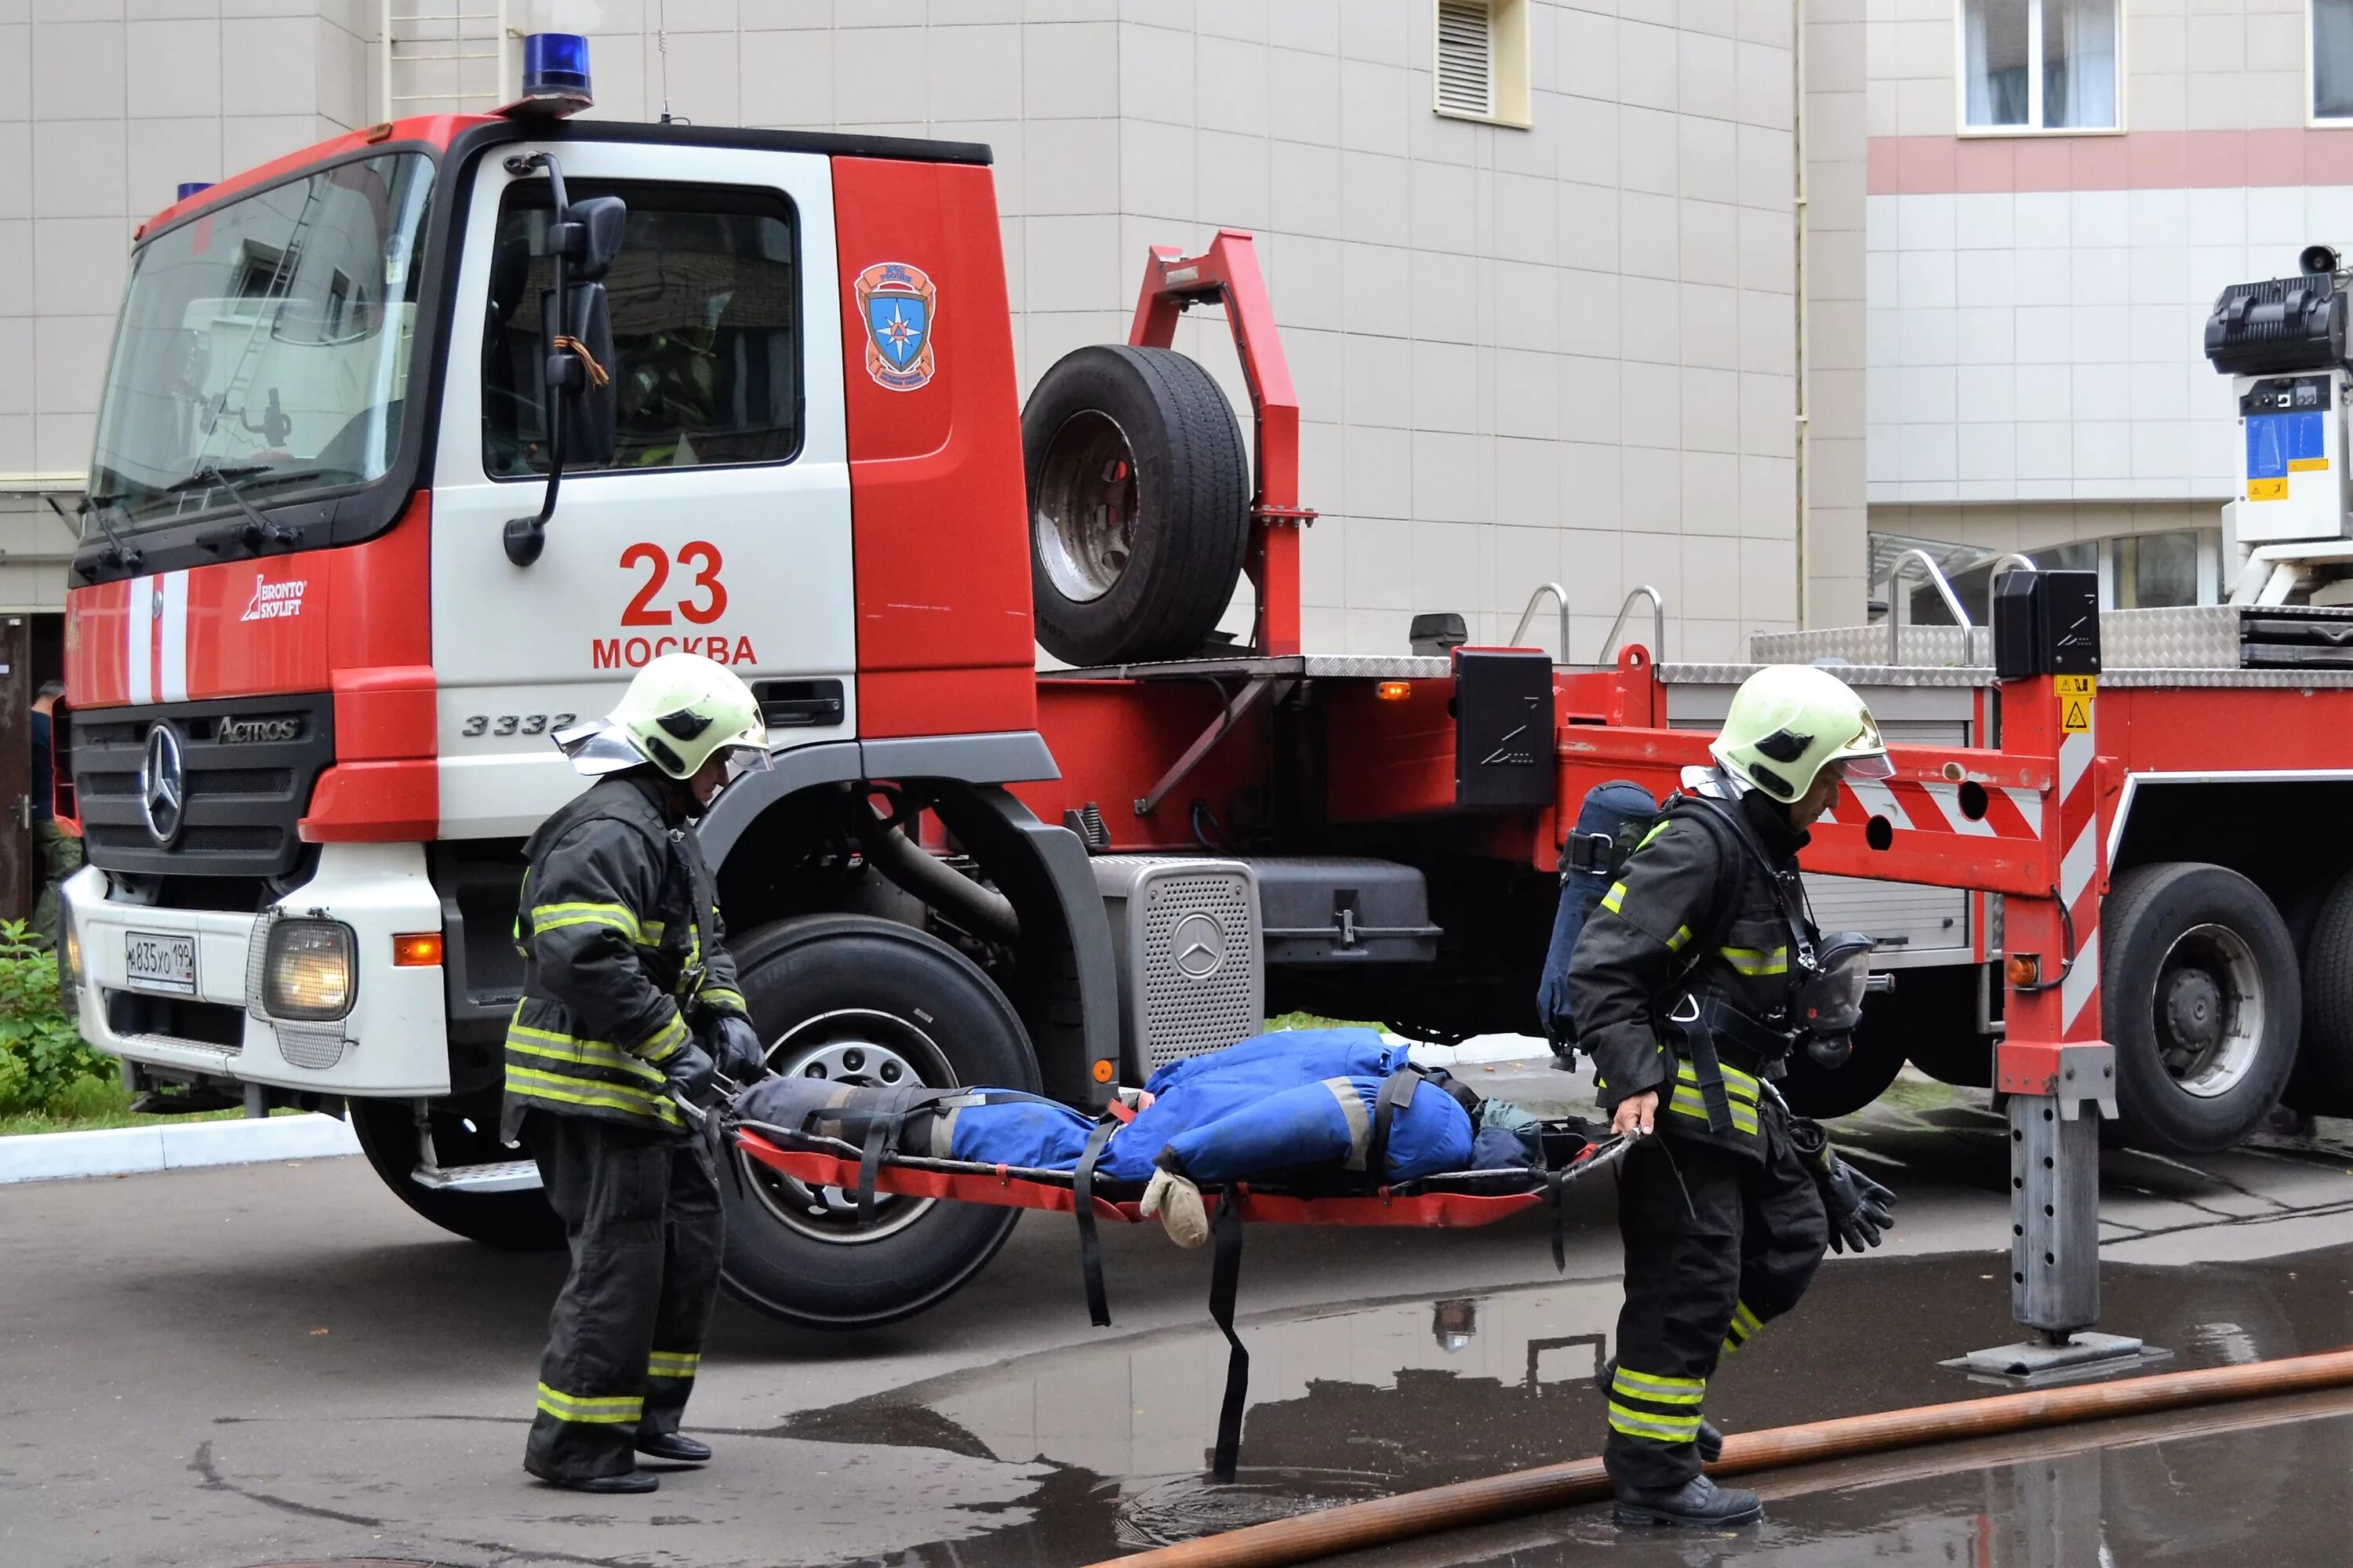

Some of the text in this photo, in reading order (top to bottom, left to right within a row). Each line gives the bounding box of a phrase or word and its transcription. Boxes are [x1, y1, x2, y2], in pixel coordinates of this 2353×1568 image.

[261, 580, 304, 602] BRONTO
[619, 540, 728, 627] 23
[260, 598, 302, 619] SKYLIFT
[592, 636, 758, 668] МОСКВА
[462, 713, 577, 737] 3332
